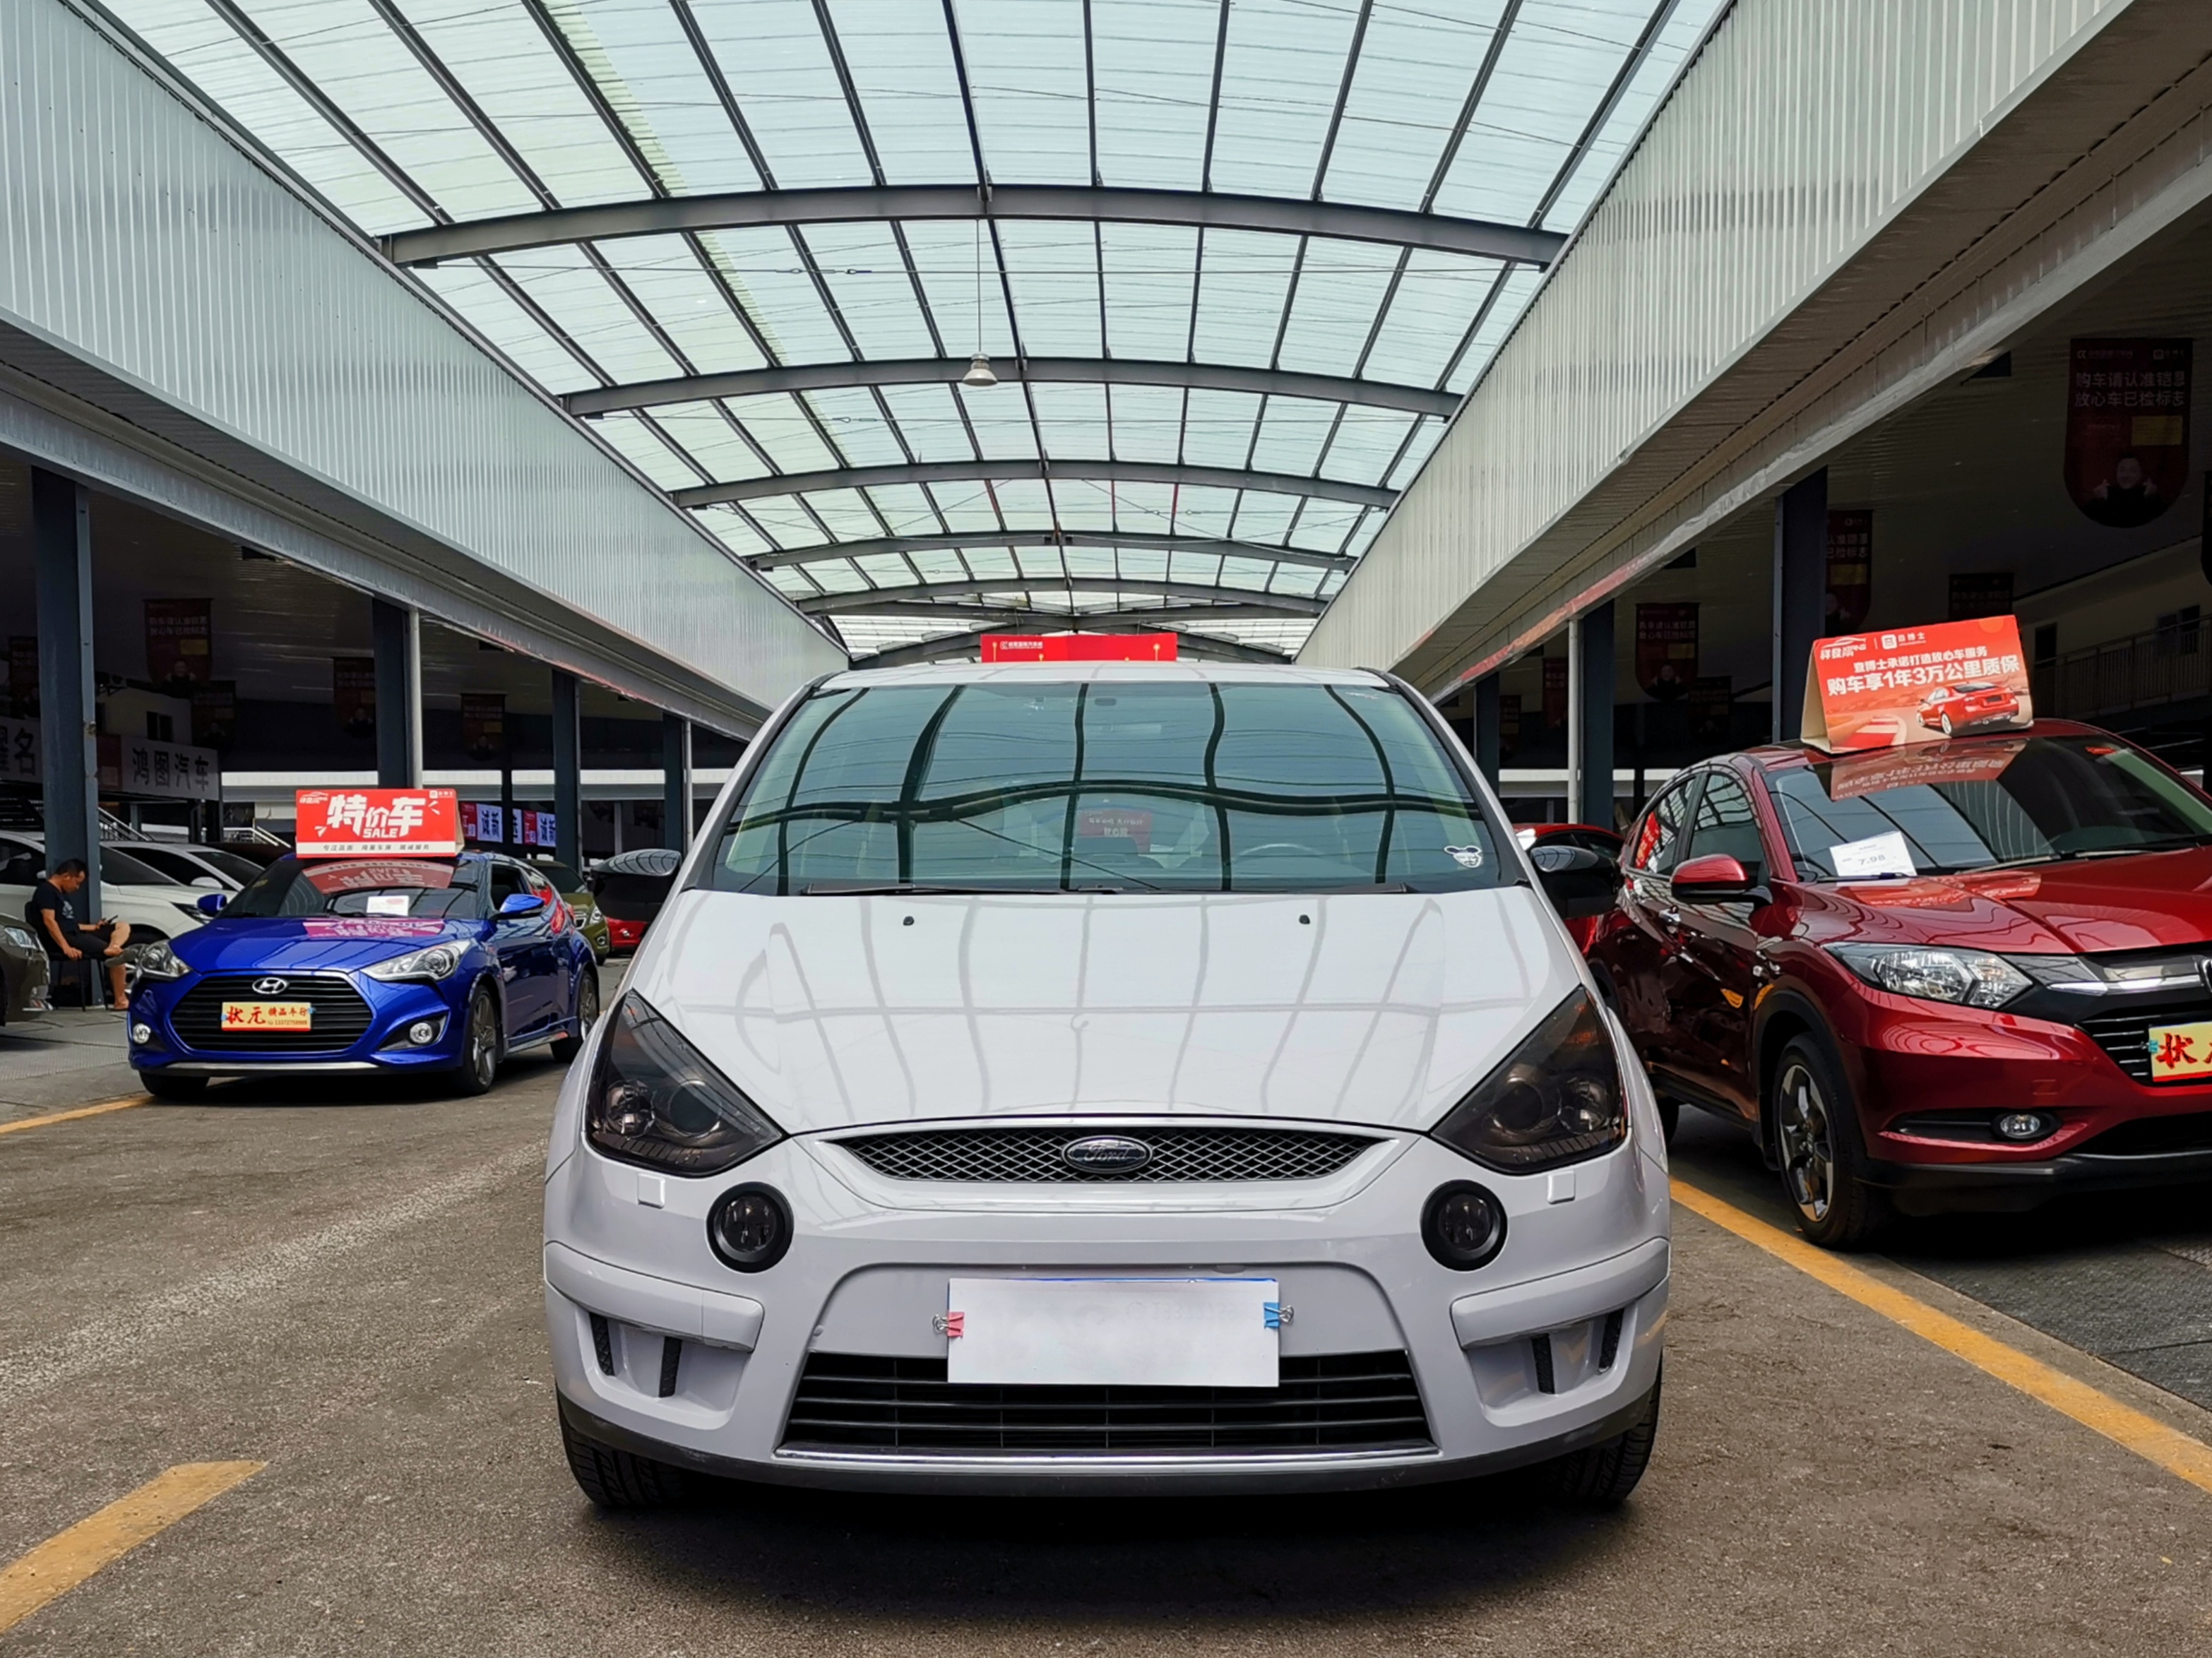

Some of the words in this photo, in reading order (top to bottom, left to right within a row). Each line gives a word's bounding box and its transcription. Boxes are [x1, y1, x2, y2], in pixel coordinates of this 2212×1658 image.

[2074, 392, 2185, 407] 放心车已检标志
[1853, 645, 1987, 674] 查博士承诺打造放心车服务
[1827, 655, 2020, 696] 购车享1年3万公里质保
[132, 747, 210, 792] 鸿图汽车
[326, 794, 427, 837] 特价车
[363, 828, 398, 838] SALE
[1857, 854, 1886, 866] 7.98
[226, 1005, 266, 1025] 状元
[2155, 1032, 2212, 1070] 状
[1083, 1143, 1129, 1162] Ford
